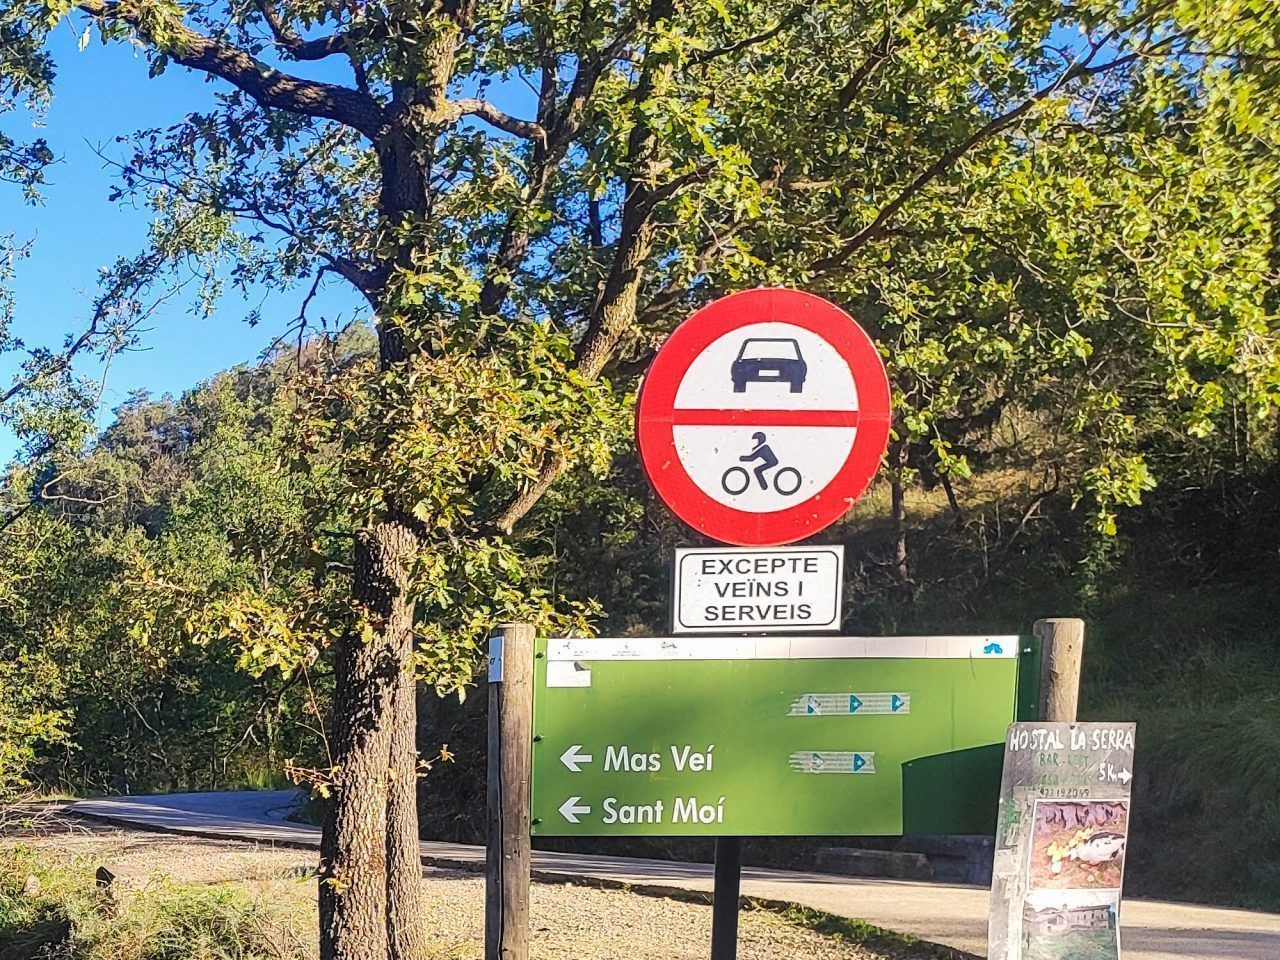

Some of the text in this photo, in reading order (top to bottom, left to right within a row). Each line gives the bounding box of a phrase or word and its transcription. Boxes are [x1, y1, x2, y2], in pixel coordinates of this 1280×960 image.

[701, 557, 819, 575] EXCEPTE
[714, 578, 803, 598] VEÏNS I
[704, 603, 812, 621] SERVEIS
[1009, 728, 1135, 751] HOSTAL LA SERRA
[603, 744, 715, 772] Mas Veí
[602, 797, 726, 824] Sant Moí
